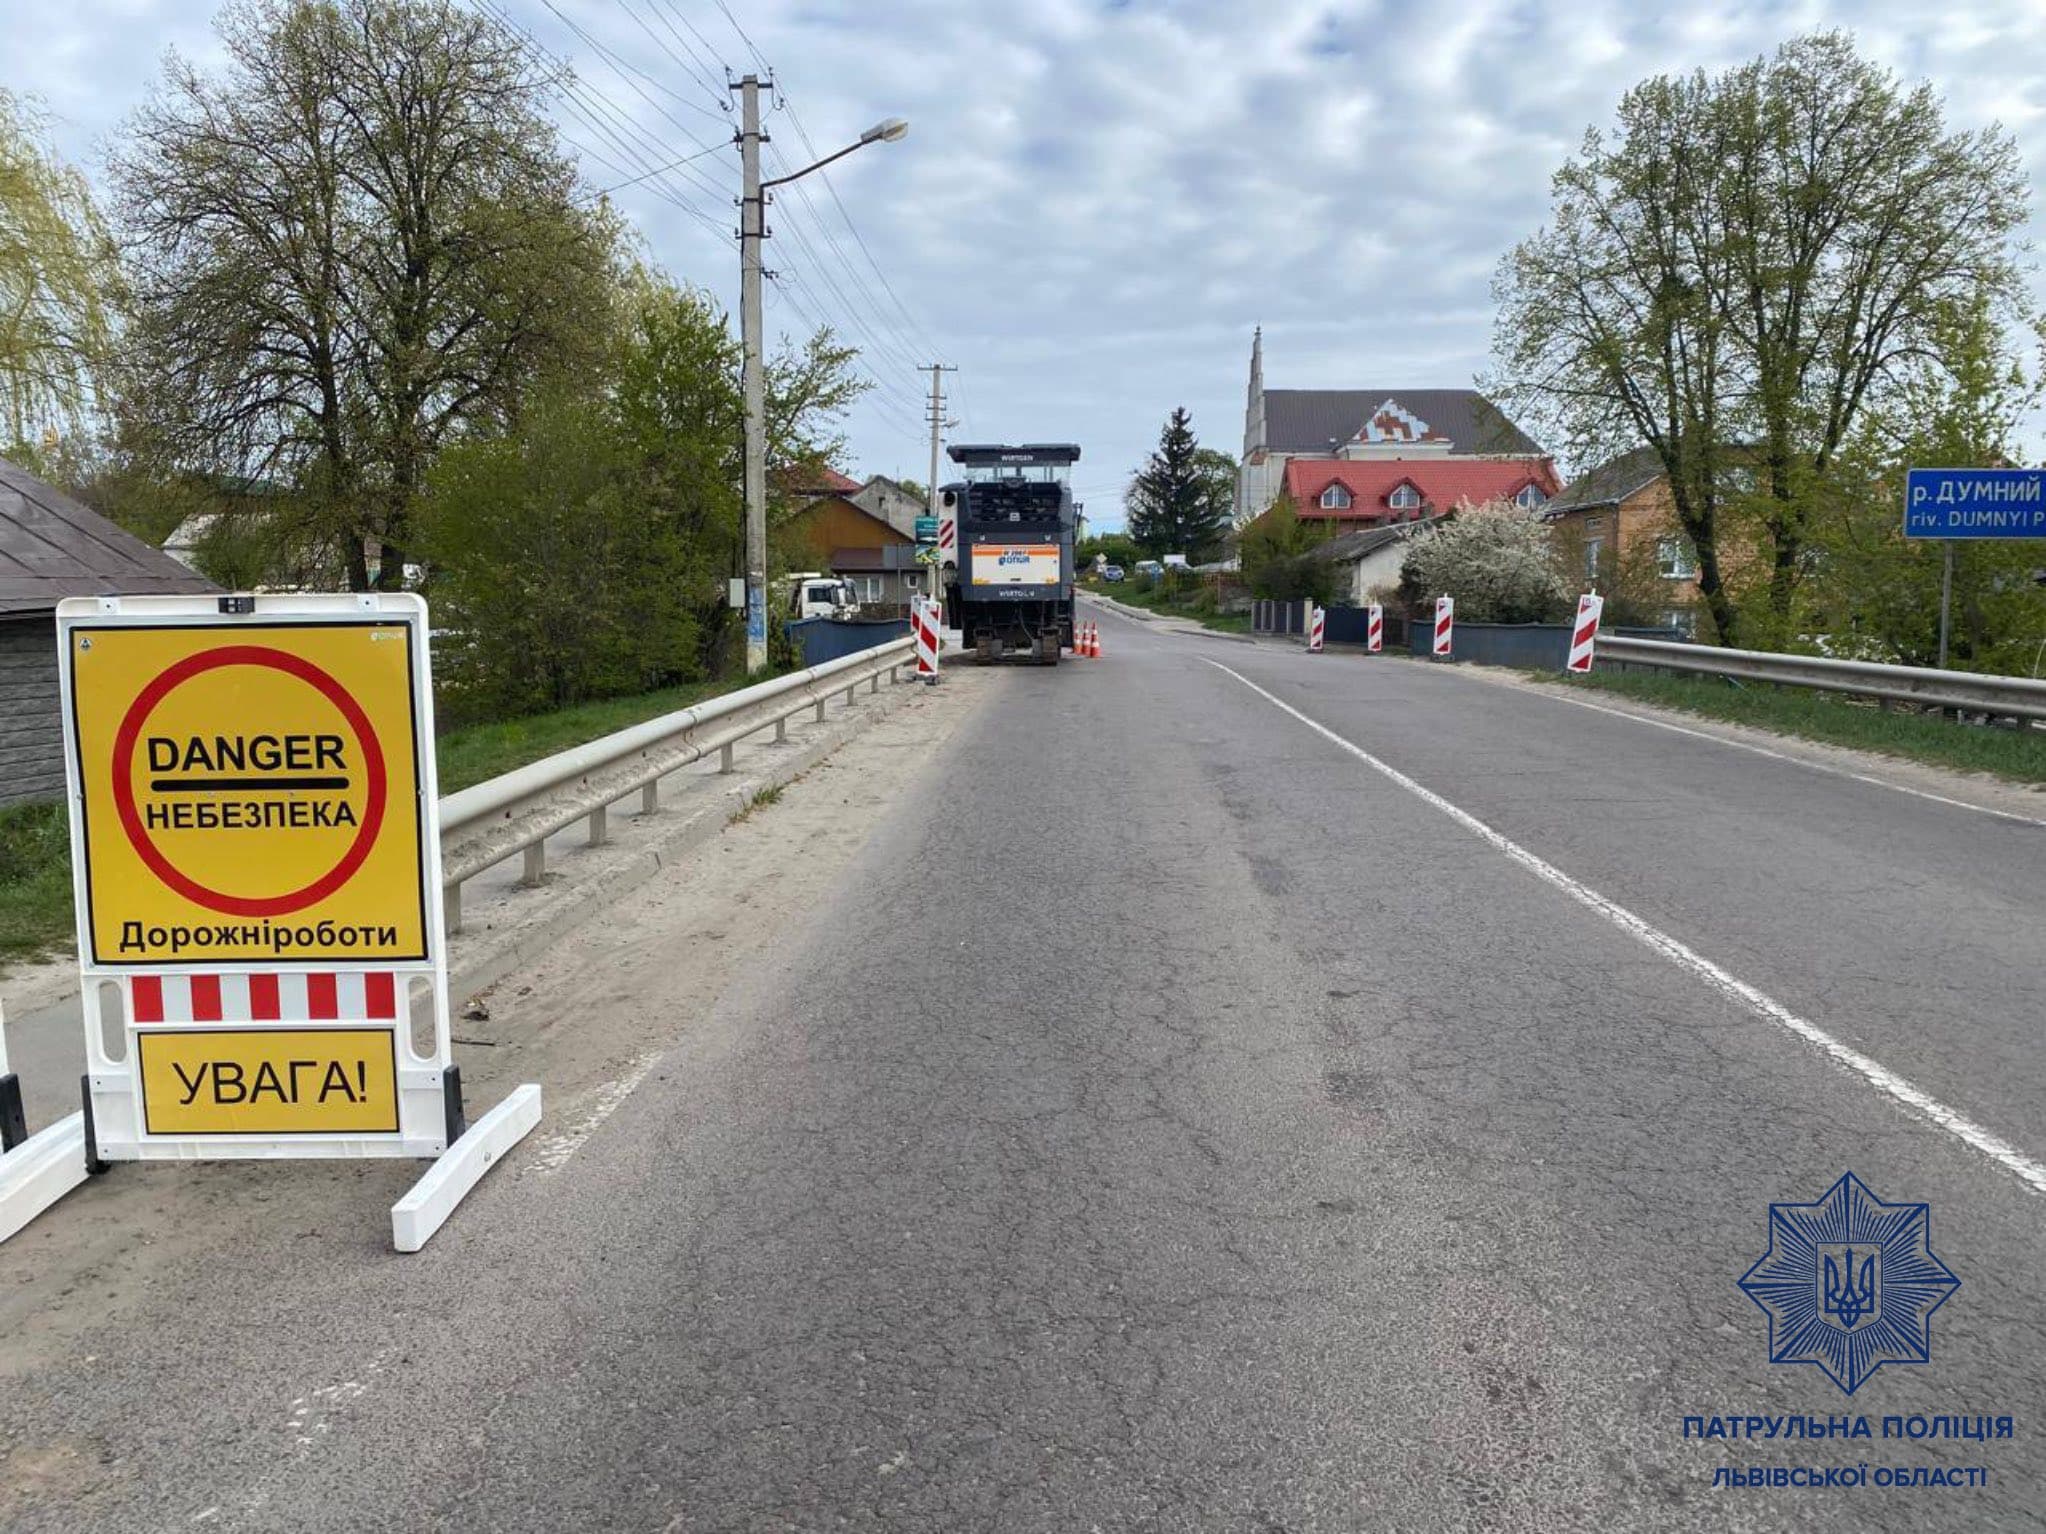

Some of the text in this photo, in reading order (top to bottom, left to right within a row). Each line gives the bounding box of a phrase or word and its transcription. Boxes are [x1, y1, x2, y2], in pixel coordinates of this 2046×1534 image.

[1913, 475, 2040, 507] р. ДУМНИЙ
[1911, 512, 1942, 527] riv.
[1948, 511, 2027, 527] DUMNYI
[147, 734, 347, 772] DANGER
[146, 801, 357, 829] НЕБЕЗПЕКА
[119, 920, 397, 953] Дорожніроботи
[172, 1061, 367, 1105] УВАГА!
